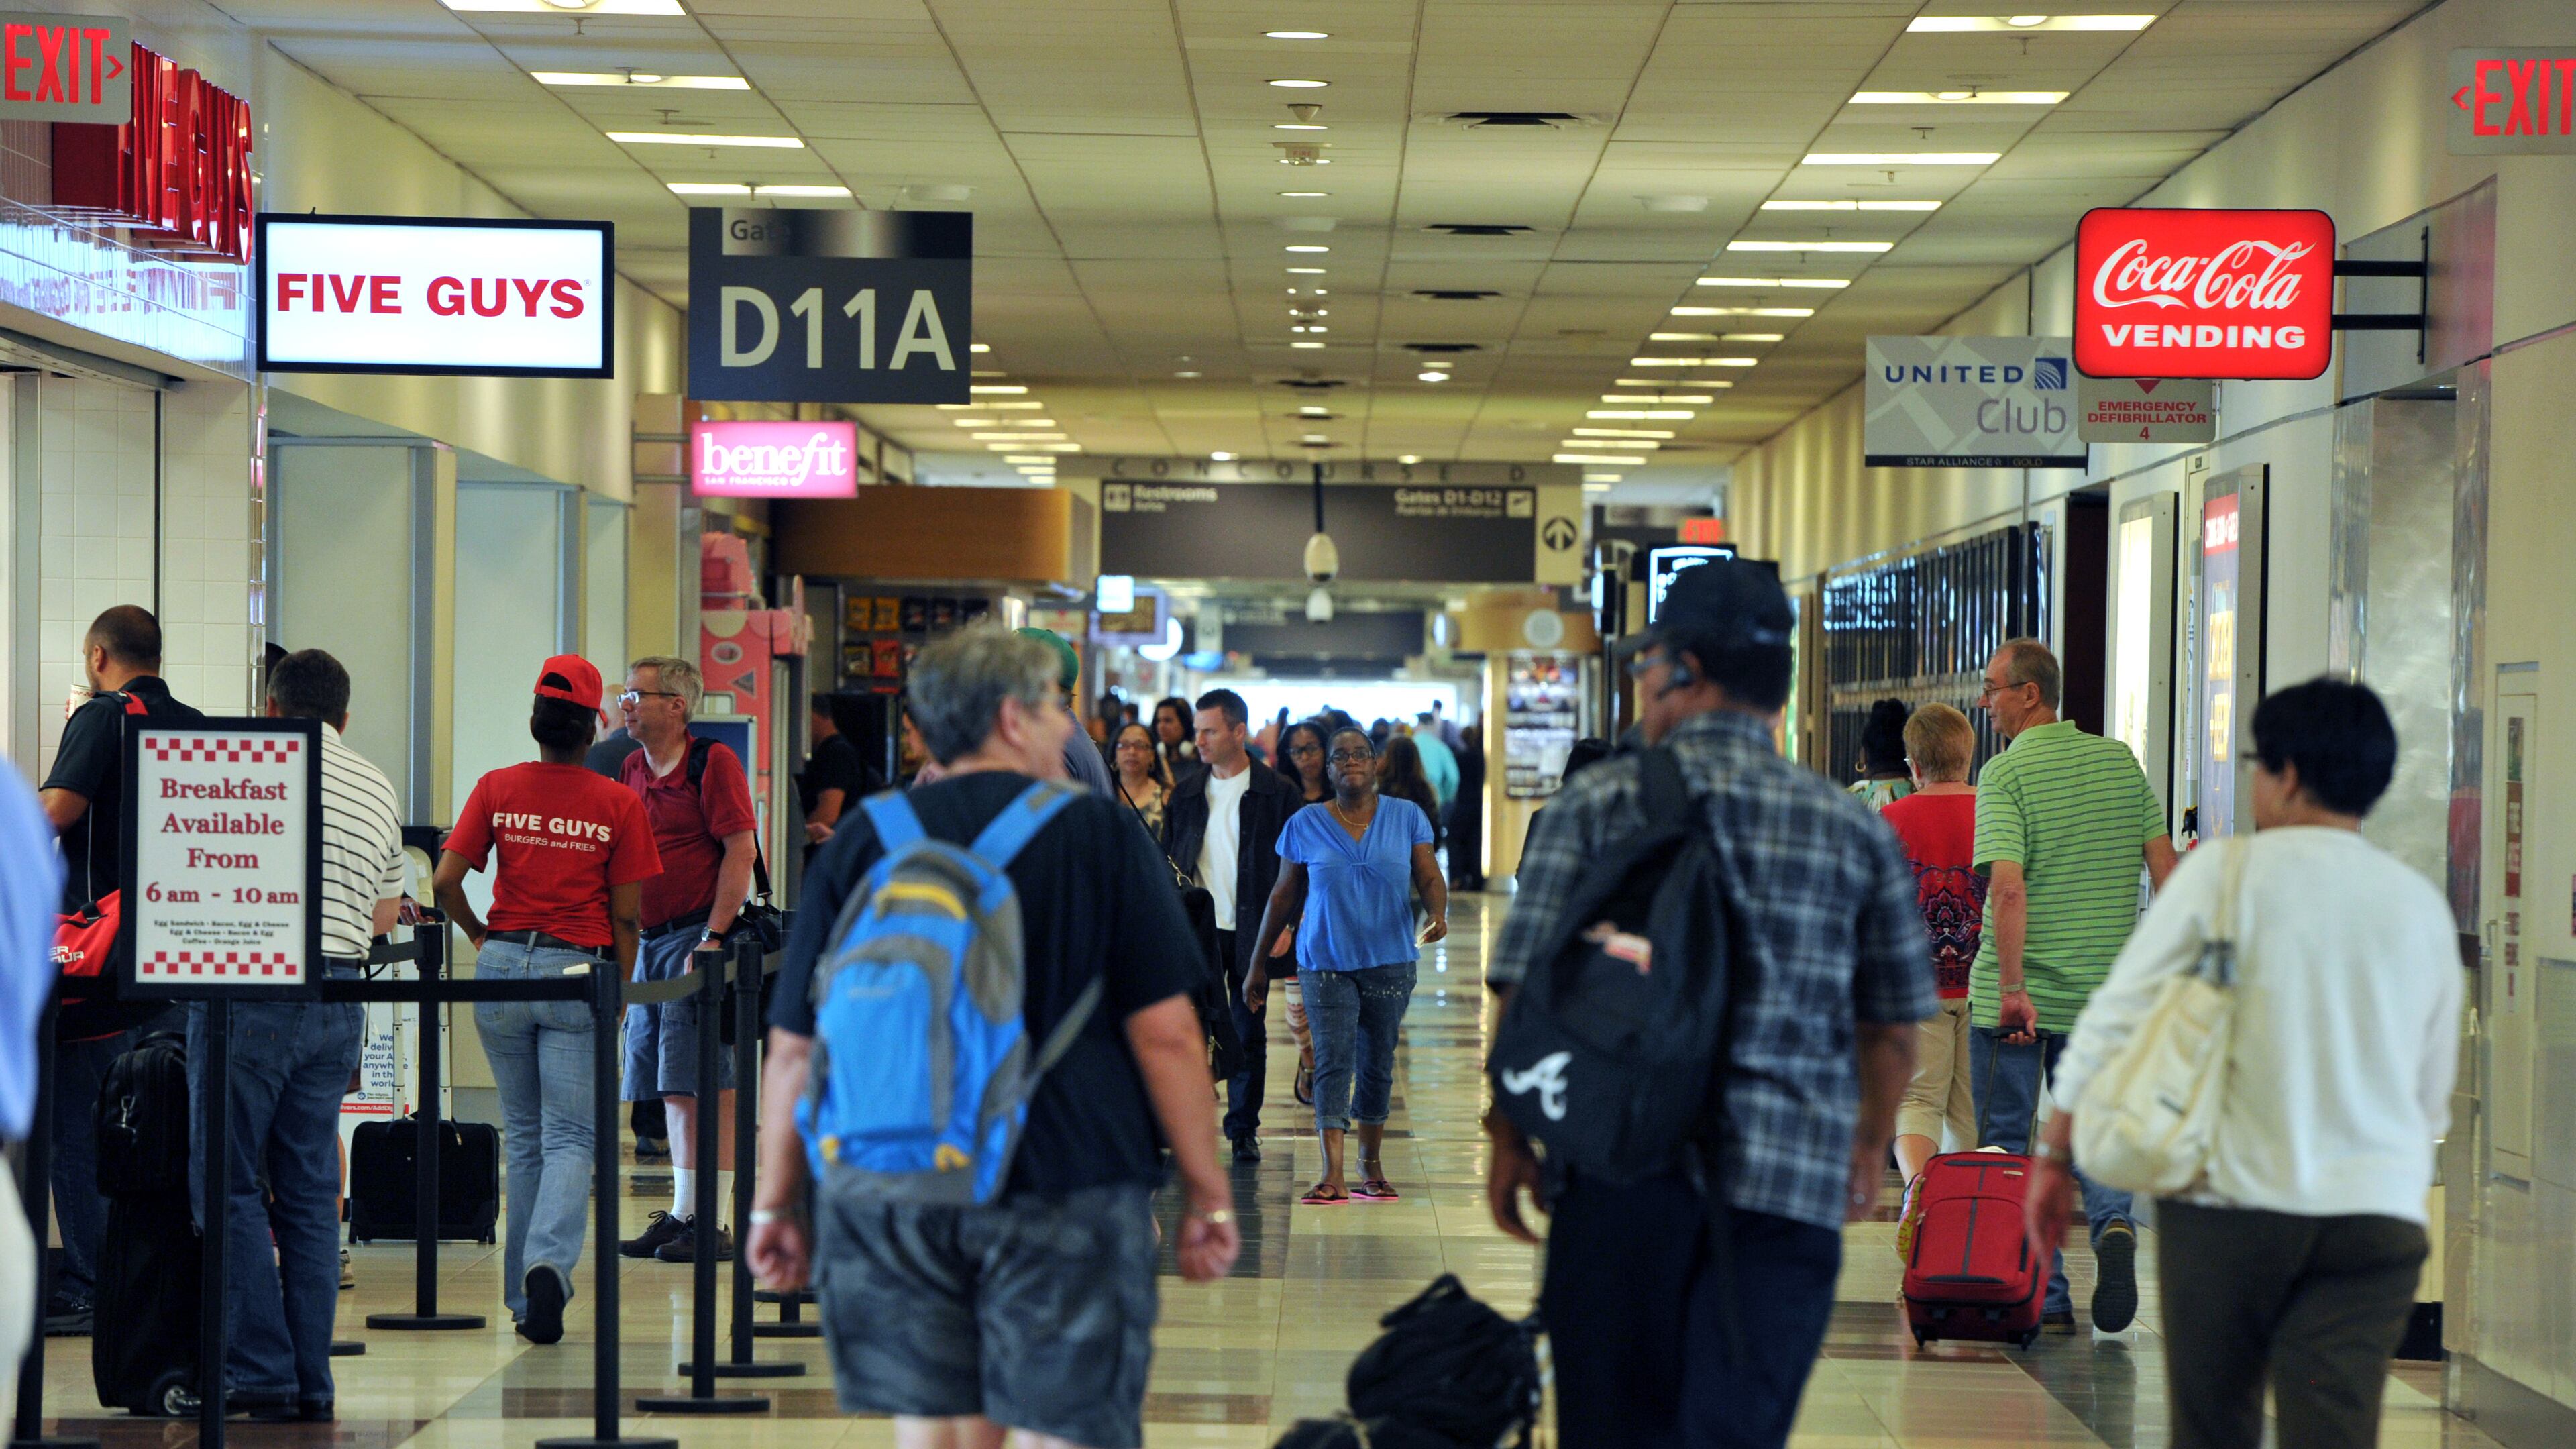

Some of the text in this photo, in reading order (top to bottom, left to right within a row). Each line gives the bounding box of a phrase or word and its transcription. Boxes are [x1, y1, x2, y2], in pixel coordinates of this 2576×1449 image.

[5, 23, 111, 104] EXIT
[2473, 58, 2576, 136] EXIT
[2092, 239, 2318, 310] Coca-Cola
[277, 272, 402, 314] FIVE
[720, 286, 957, 371] D11A
[2101, 324, 2306, 349] VENDING
[1885, 365, 2024, 383] UNITED
[1977, 398, 2068, 433] Club
[2098, 400, 2197, 411] EMERGENCY
[2088, 413, 2207, 423] DEFIBRILLATOR
[2139, 427, 2150, 440] 4
[700, 431, 847, 487] benefit
[1906, 458, 2043, 467] STAR ALLIANCE GOLD
[729, 476, 789, 486] FRANCISCO
[1134, 484, 1217, 502] Restrooms
[1395, 489, 1440, 504] Gates
[160, 777, 287, 800] Breakfast
[161, 812, 285, 835] Available
[492, 812, 610, 843] FIVE GUYS
[504, 833, 596, 852] BURGERS and FRIES
[186, 847, 259, 869] From
[146, 881, 162, 902] 6
[167, 890, 200, 902] am
[233, 887, 262, 903] 10
[266, 891, 299, 904] am
[380, 1034, 394, 1042] We
[364, 1053, 384, 1061] your
